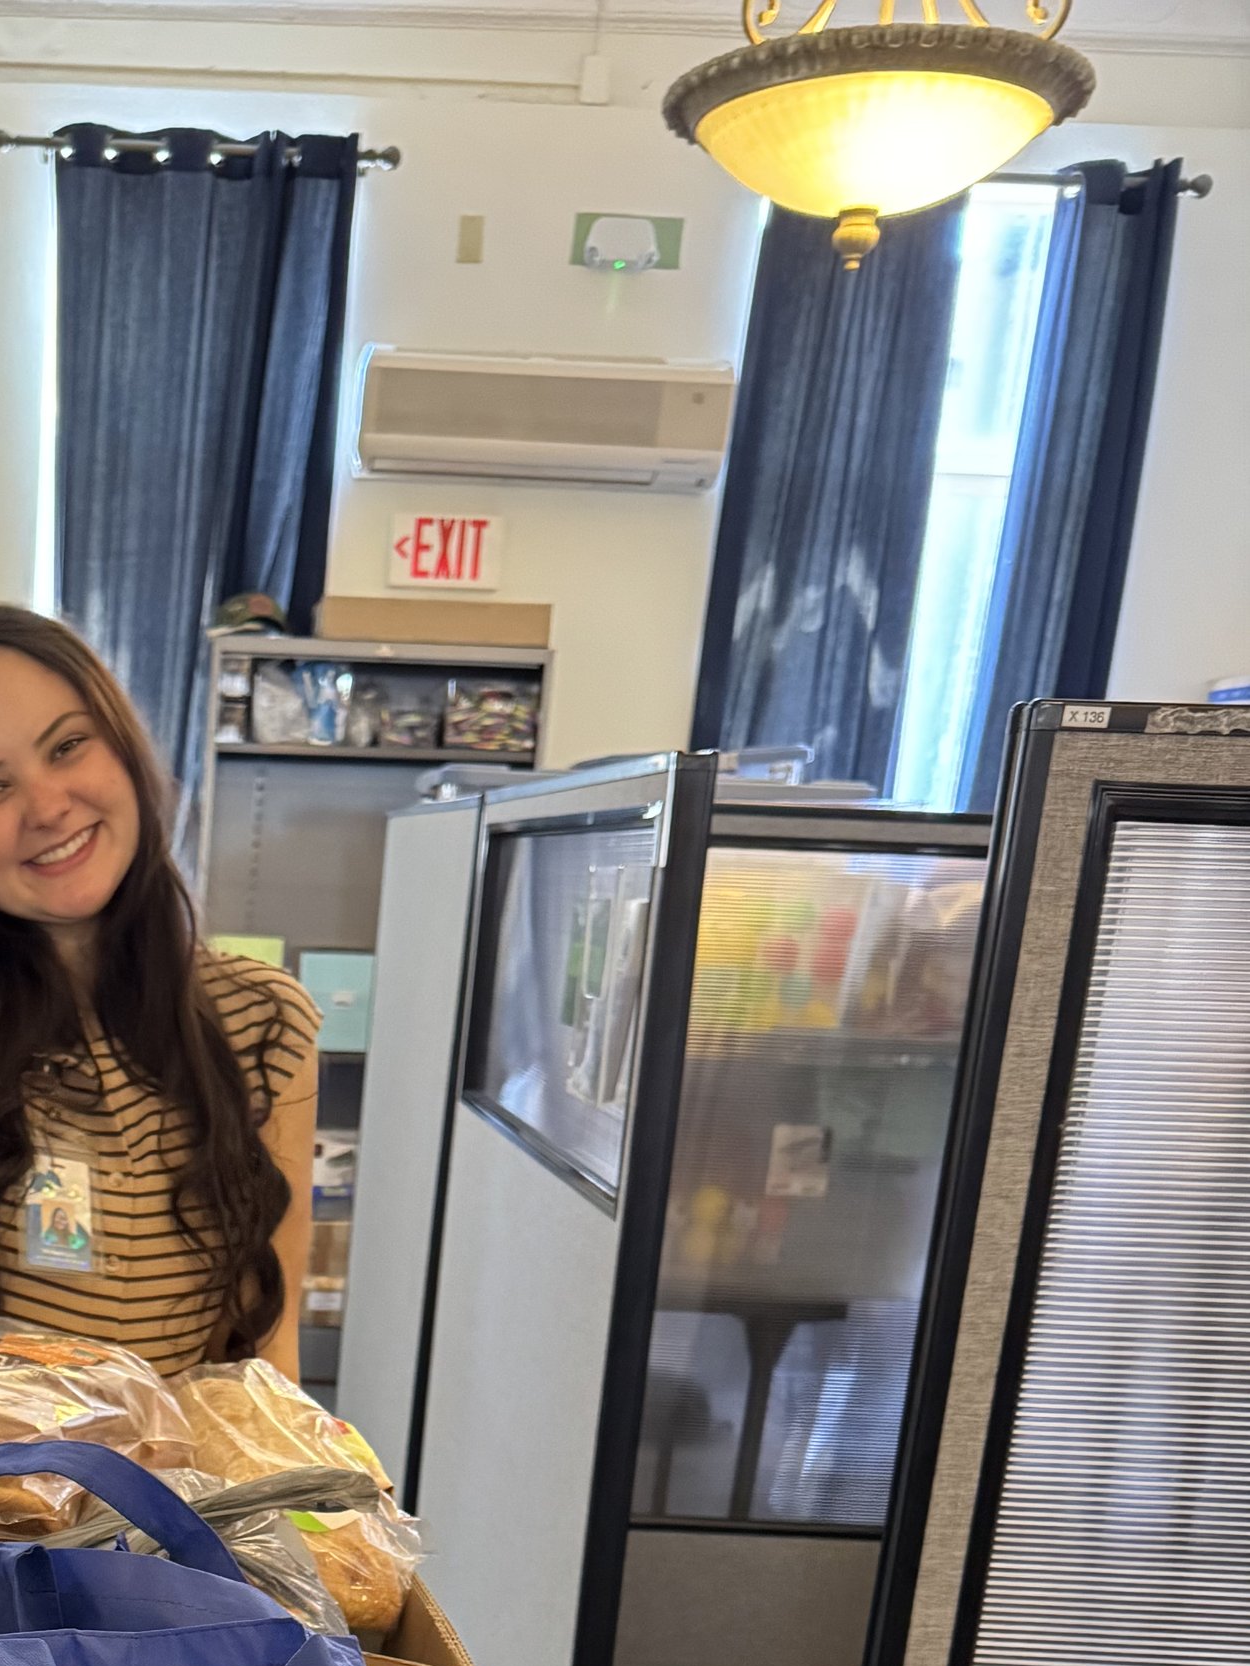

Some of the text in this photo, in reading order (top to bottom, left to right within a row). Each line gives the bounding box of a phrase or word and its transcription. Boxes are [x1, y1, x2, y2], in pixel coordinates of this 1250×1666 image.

[410, 517, 490, 581] EXIT
[1069, 710, 1105, 723] X 136
